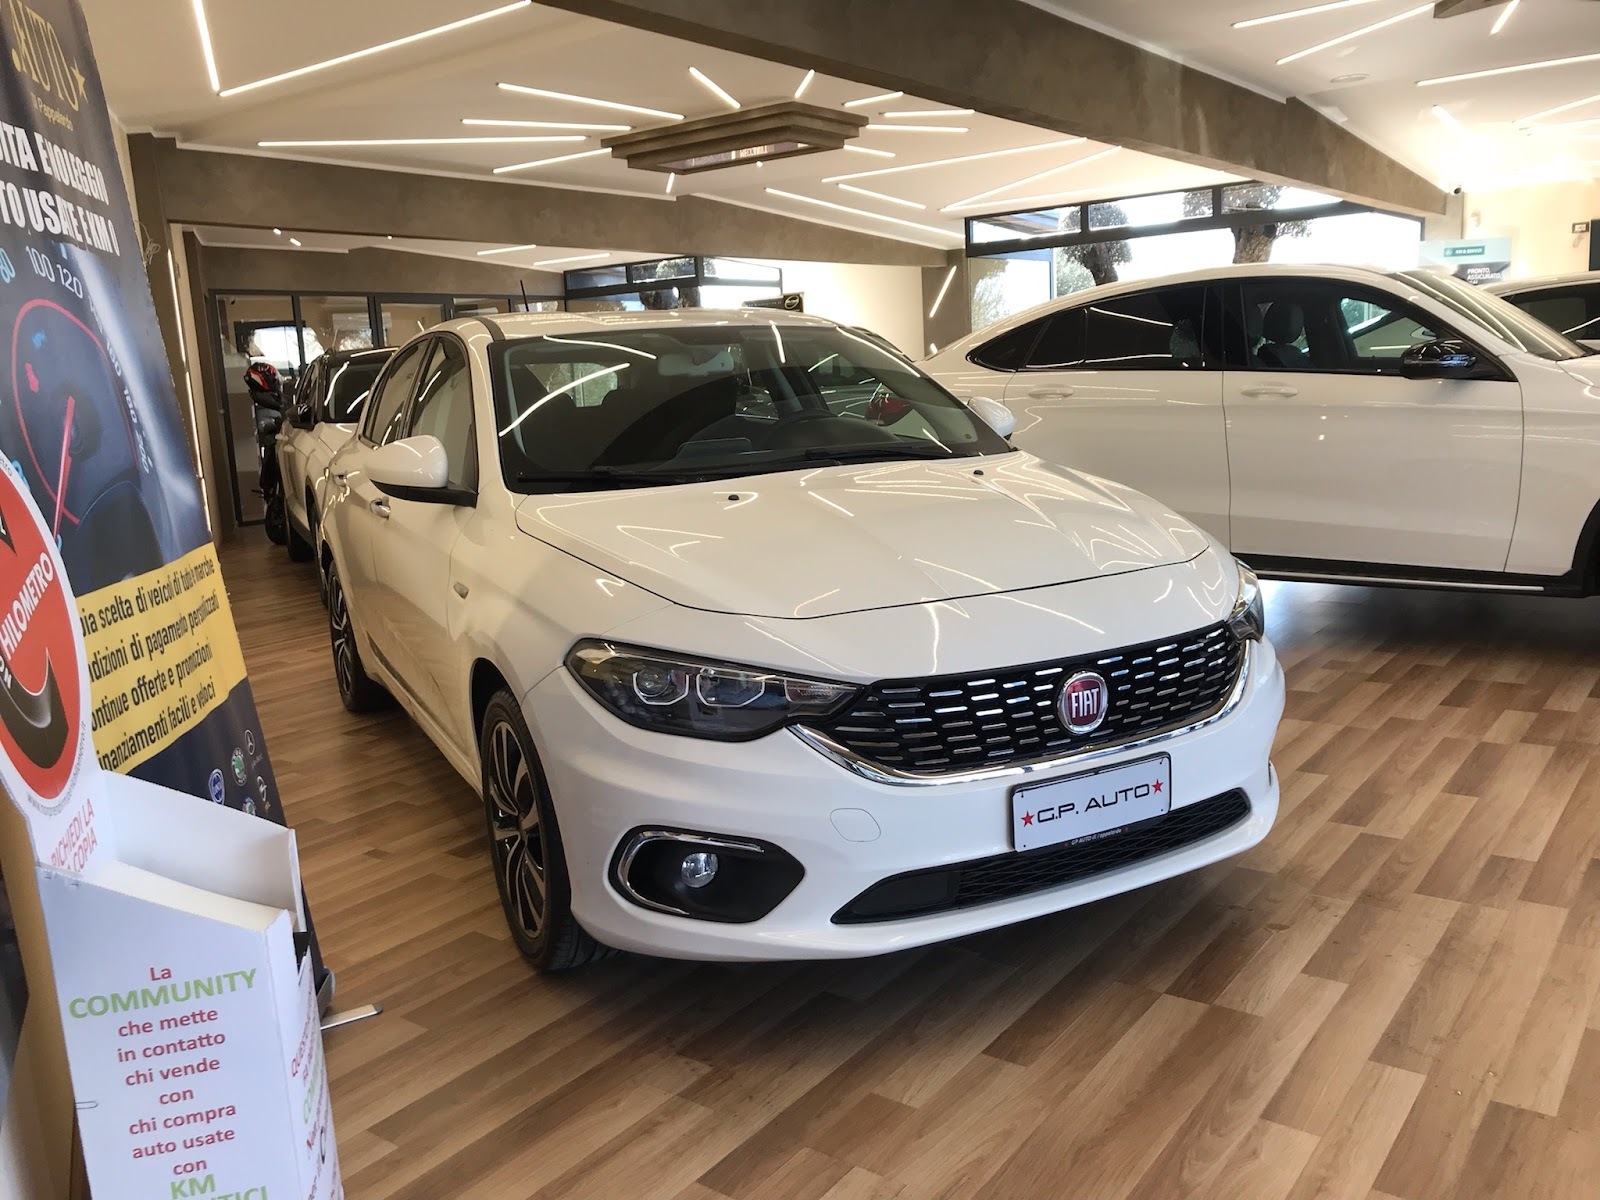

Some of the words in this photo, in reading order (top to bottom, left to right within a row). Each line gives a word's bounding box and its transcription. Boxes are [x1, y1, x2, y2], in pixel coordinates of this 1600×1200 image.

[0, 119, 39, 172] ITA
[22, 187, 84, 243] USATE
[26, 246, 56, 283] 100
[57, 264, 84, 299] 120
[98, 595, 134, 629] scelta
[135, 586, 149, 614] di
[173, 571, 182, 596] di
[130, 633, 144, 661] di
[145, 613, 188, 661] pagamento
[131, 670, 167, 706] offerte
[168, 667, 175, 686] e
[175, 636, 213, 688] promozioni
[168, 695, 191, 731] facili
[191, 697, 197, 715] e
[1071, 687, 1100, 719] FIAT
[82, 798, 95, 828] LA
[1037, 802, 1079, 823] G.P.
[1084, 783, 1150, 813] AUTO
[74, 826, 98, 873] COPIA
[150, 966, 172, 982] La
[69, 967, 257, 1019] COMMUNITY
[118, 1020, 153, 1037] che
[159, 1008, 219, 1031] mette
[117, 1048, 137, 1063] in
[142, 1032, 226, 1059] contatto
[125, 1068, 154, 1086] chi
[160, 1057, 221, 1081] vende
[159, 1088, 194, 1106] con
[129, 1117, 157, 1135] chi
[163, 1104, 237, 1130] compra
[132, 1140, 176, 1160] auto
[183, 1129, 236, 1152] usate
[173, 1159, 208, 1176] con
[170, 1173, 216, 1200] KM
